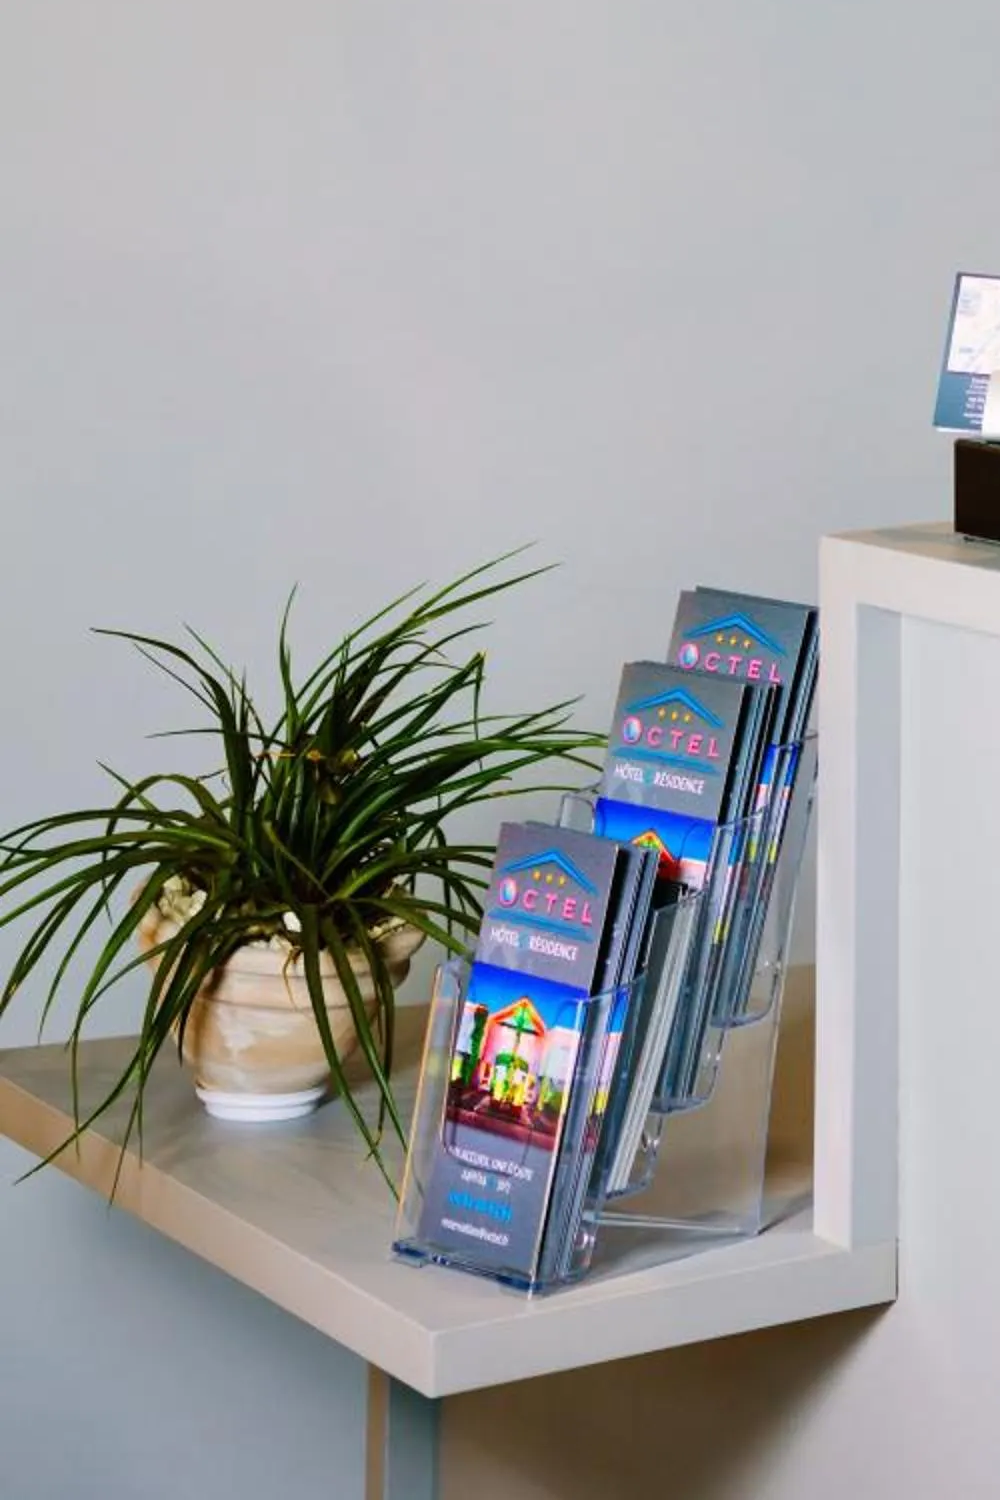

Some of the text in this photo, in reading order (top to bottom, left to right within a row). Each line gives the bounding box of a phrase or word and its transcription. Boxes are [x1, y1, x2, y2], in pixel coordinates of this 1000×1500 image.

[679, 643, 782, 684] OCTEL
[622, 716, 720, 758] OCTEL
[498, 876, 593, 926] OCTEL
